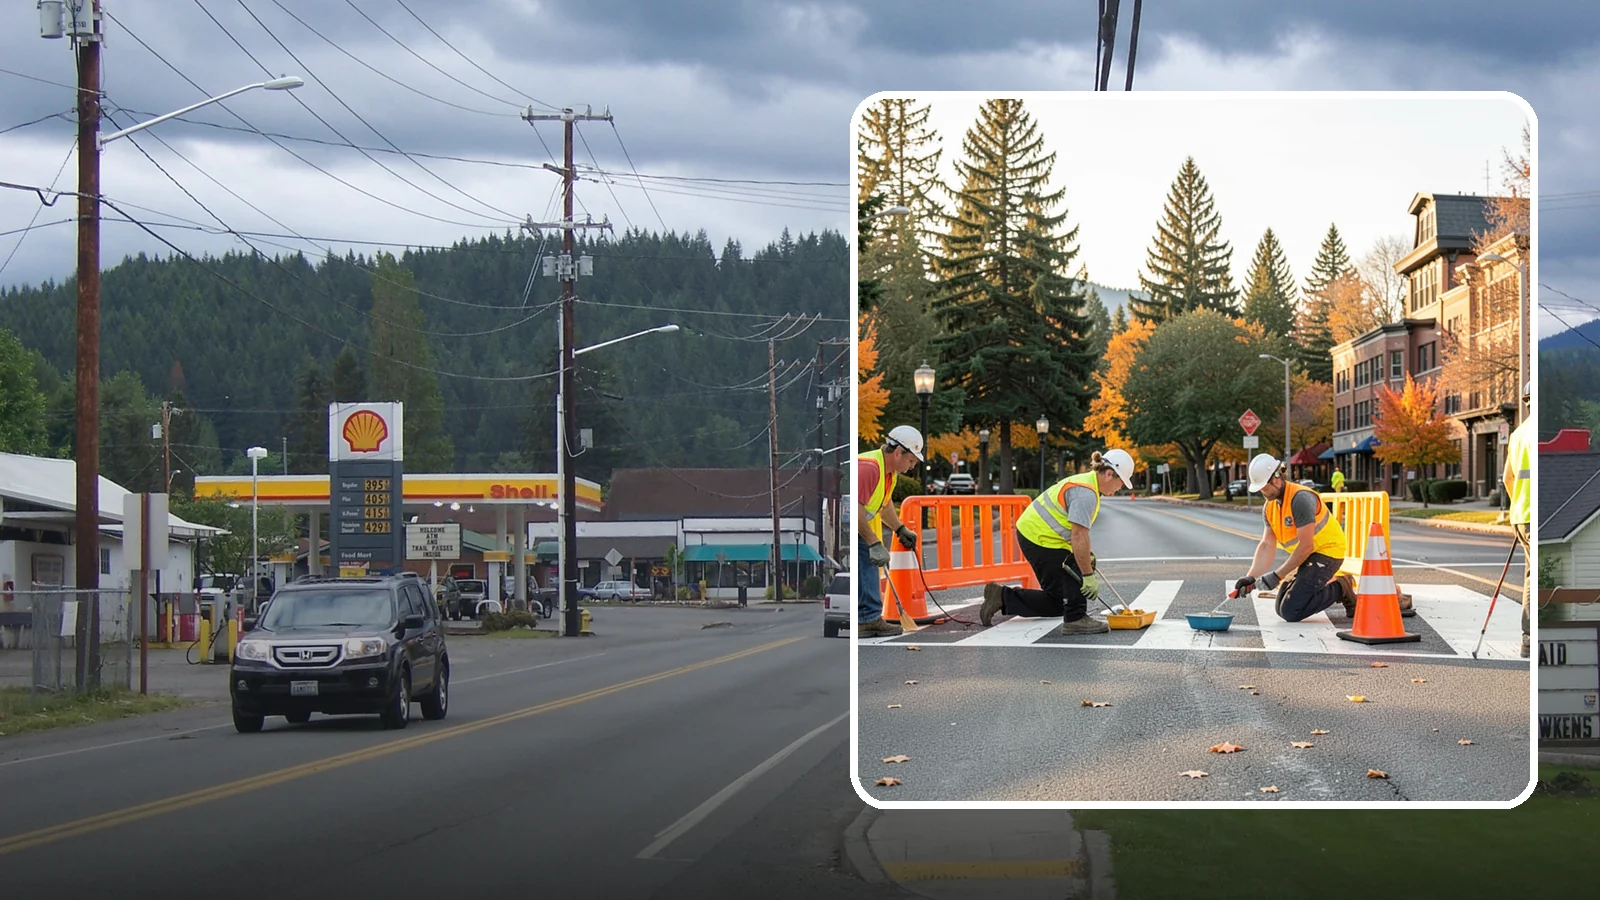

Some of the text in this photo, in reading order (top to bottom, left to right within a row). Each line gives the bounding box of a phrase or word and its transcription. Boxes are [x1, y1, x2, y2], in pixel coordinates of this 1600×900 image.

[366, 480, 383, 490] 395
[490, 484, 547, 498] Shell
[366, 494, 383, 504] 405
[366, 508, 383, 518] 415
[366, 522, 383, 533] 429
